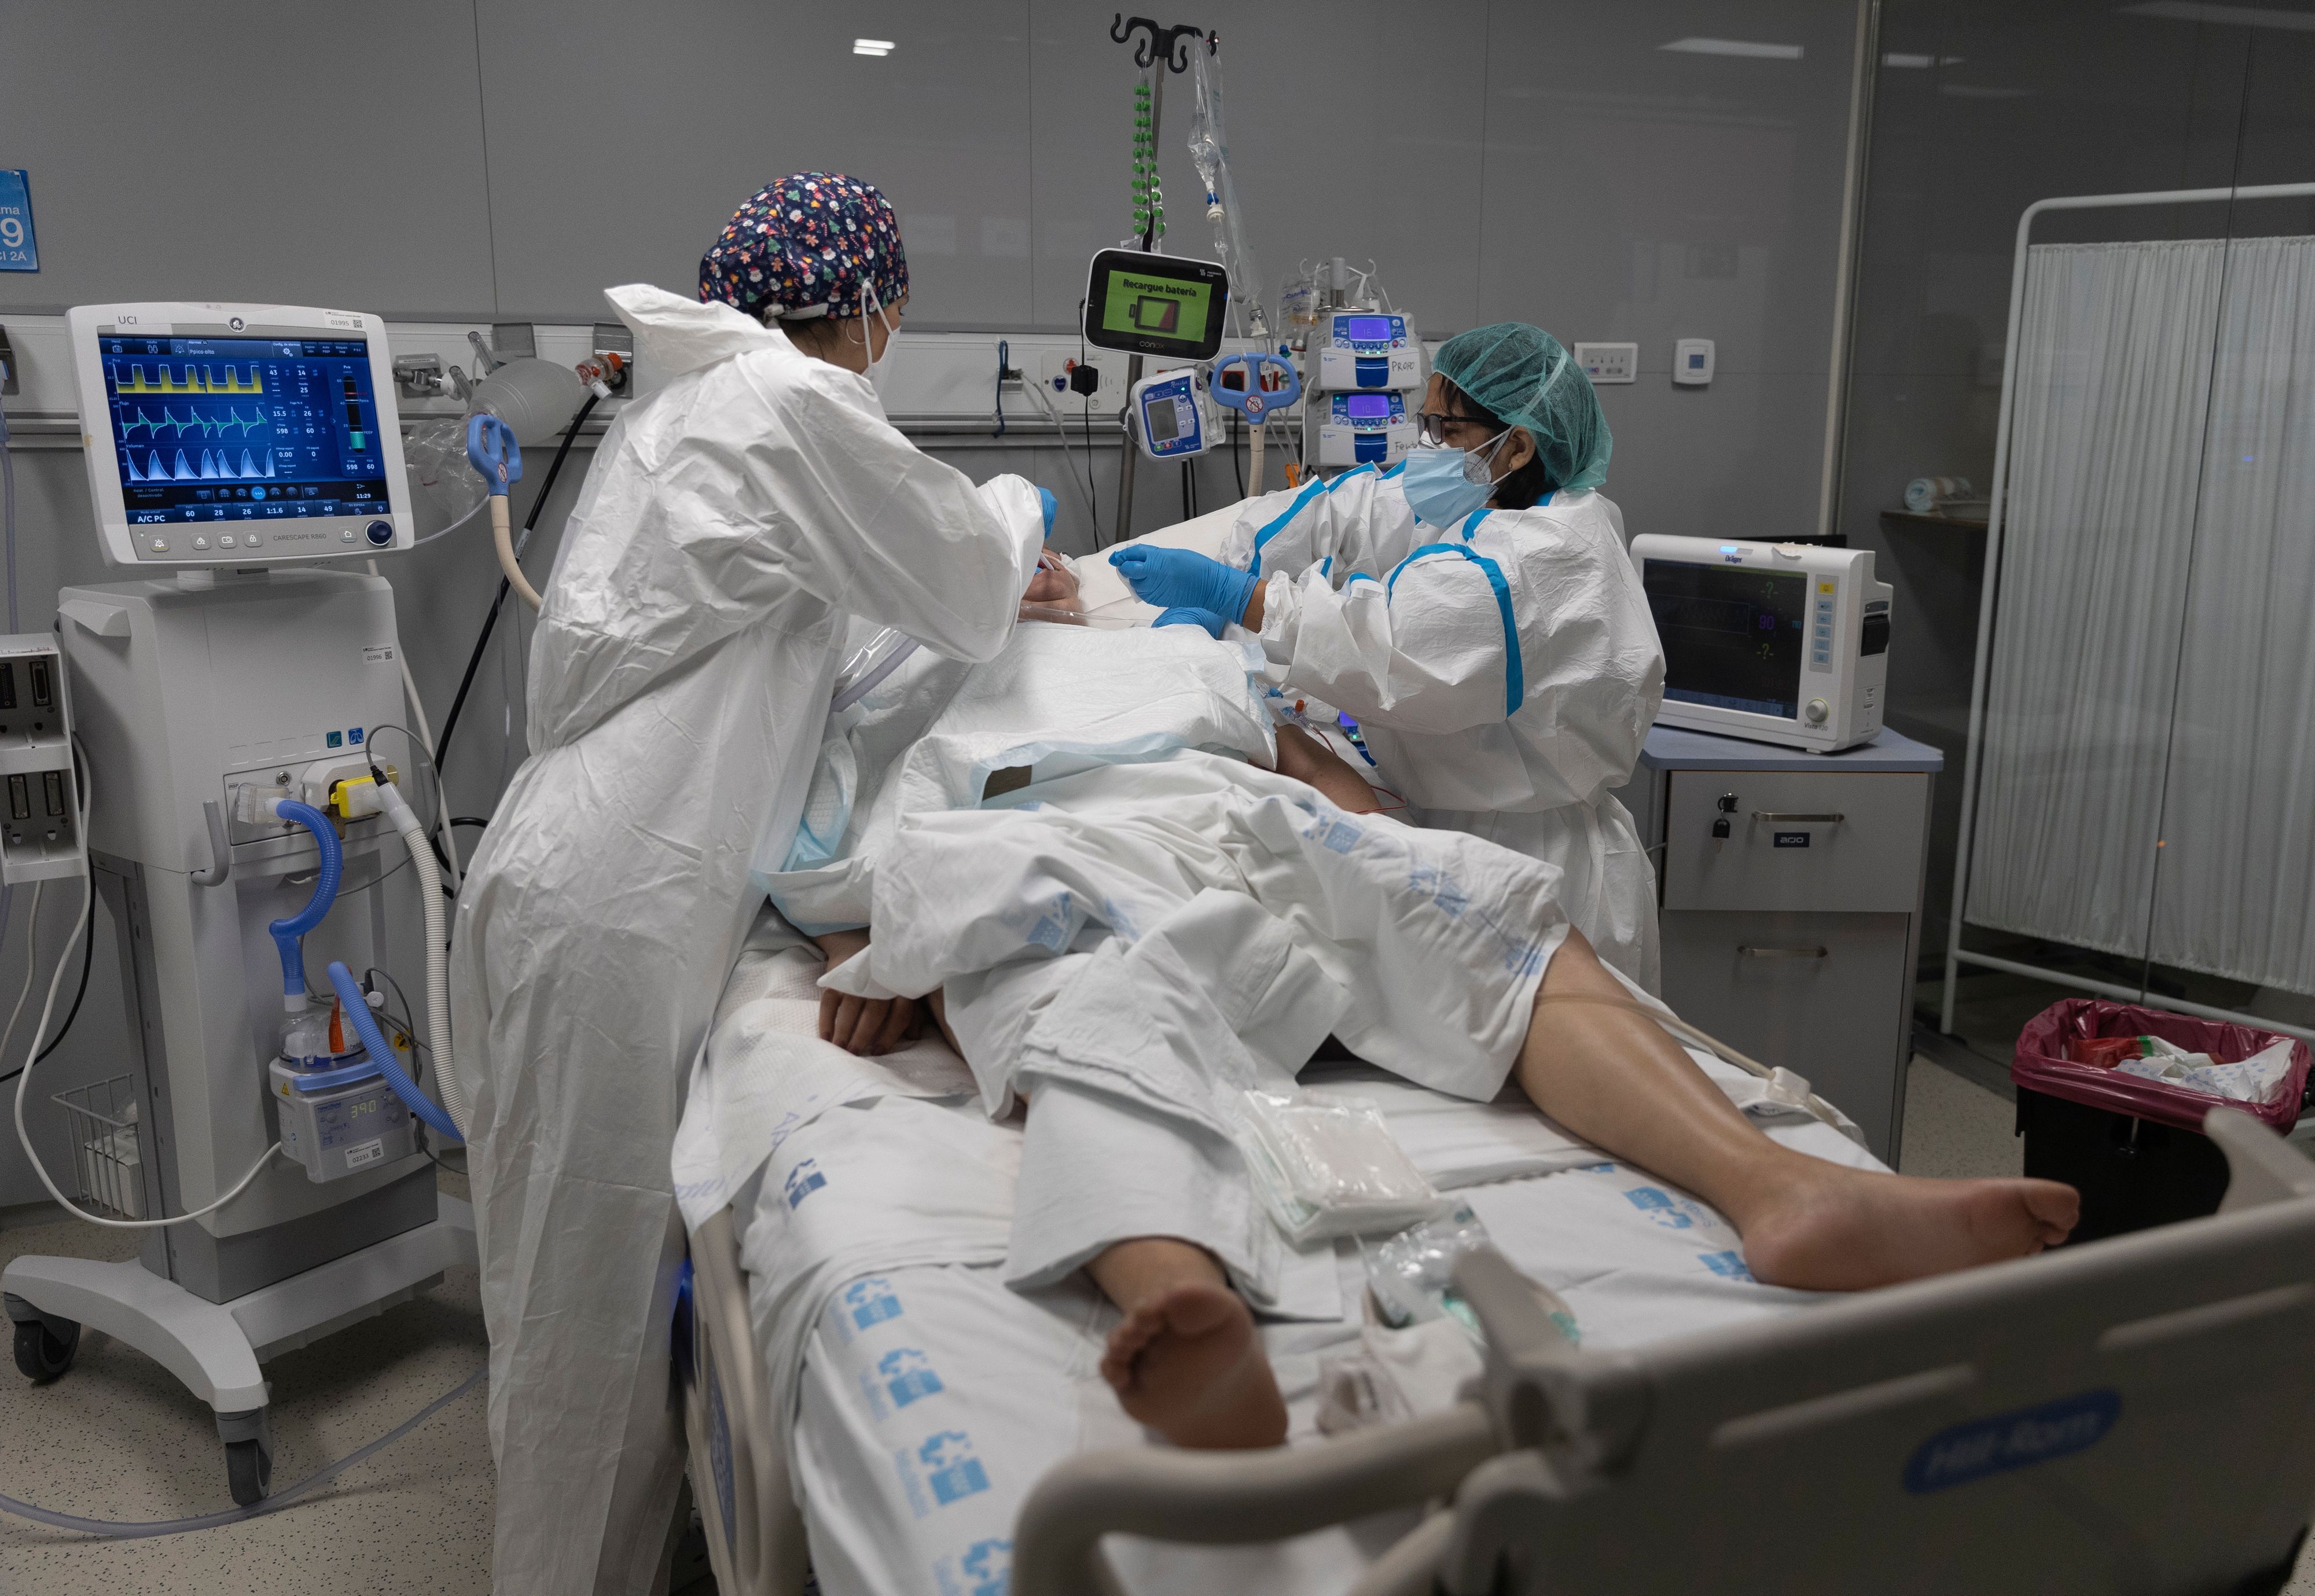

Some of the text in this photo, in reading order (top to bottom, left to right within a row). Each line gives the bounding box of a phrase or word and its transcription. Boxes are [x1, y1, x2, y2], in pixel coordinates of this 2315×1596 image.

[1, 218, 24, 247] 9
[10, 251, 27, 261] 2A
[1123, 279, 1197, 297] Recargue batería
[118, 316, 137, 324] UCI
[1759, 615, 1774, 630] 90
[352, 1153, 369, 1163] 02233
